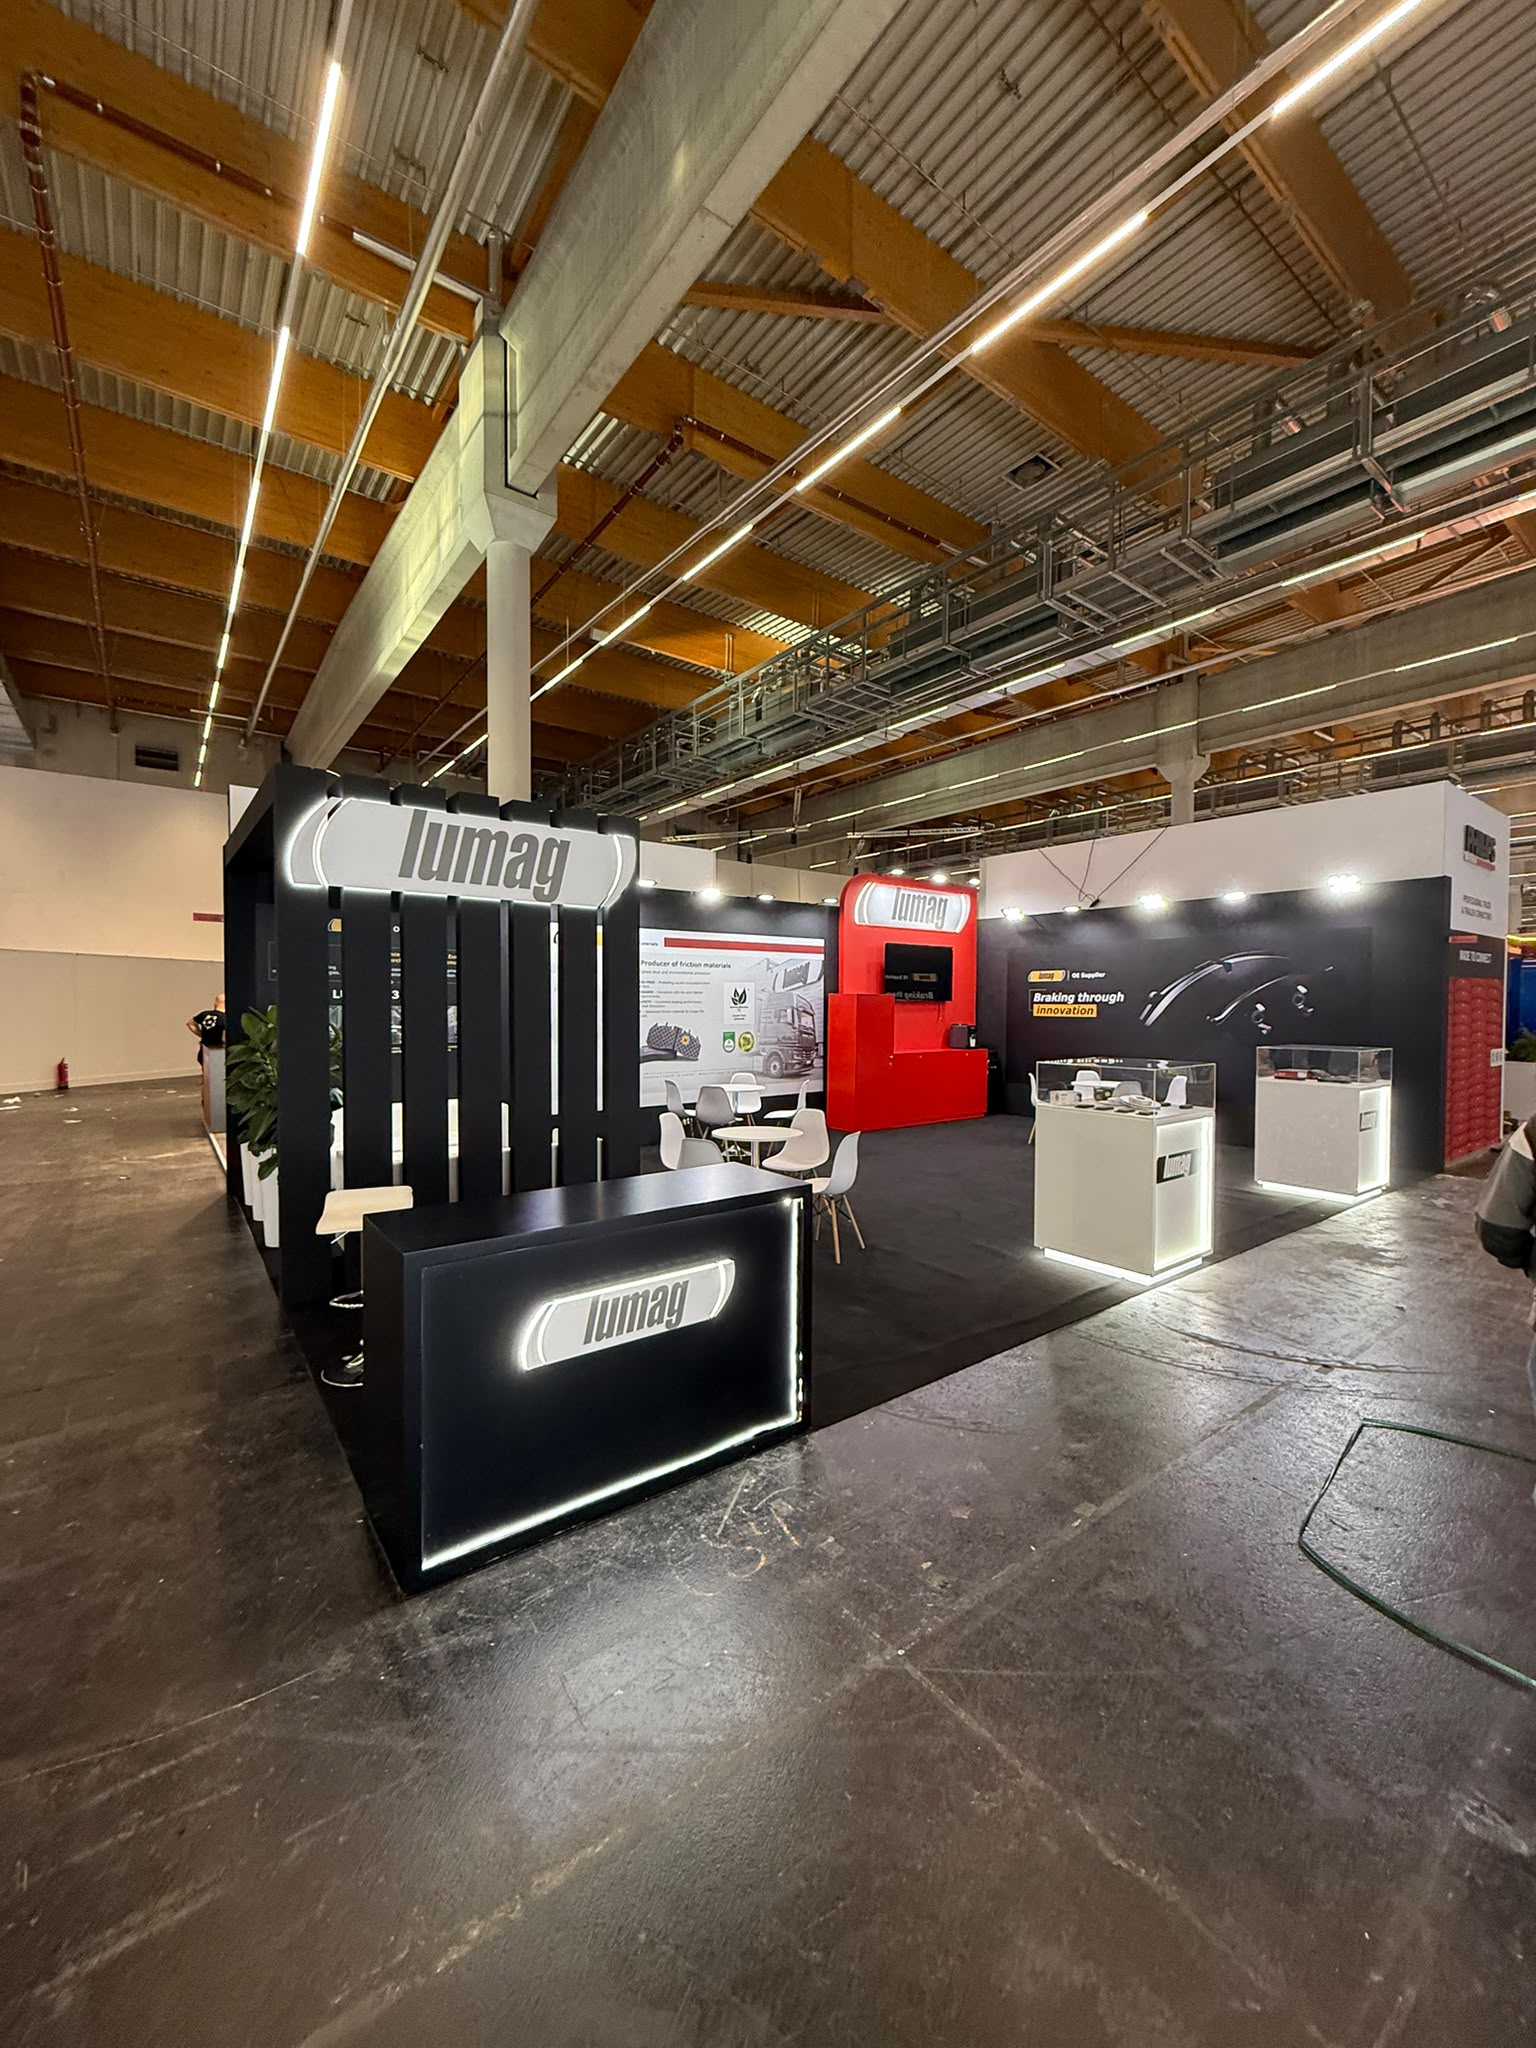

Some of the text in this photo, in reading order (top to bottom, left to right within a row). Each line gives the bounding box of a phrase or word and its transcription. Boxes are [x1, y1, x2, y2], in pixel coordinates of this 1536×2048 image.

[398, 809, 572, 903] lumag
[892, 887, 949, 930] lumag
[641, 959, 670, 967] Producer
[1033, 991, 1125, 1005] Braking through
[1036, 1006, 1094, 1016] innovation
[1163, 1152, 1192, 1179] lumag
[583, 1280, 690, 1345] lumag
